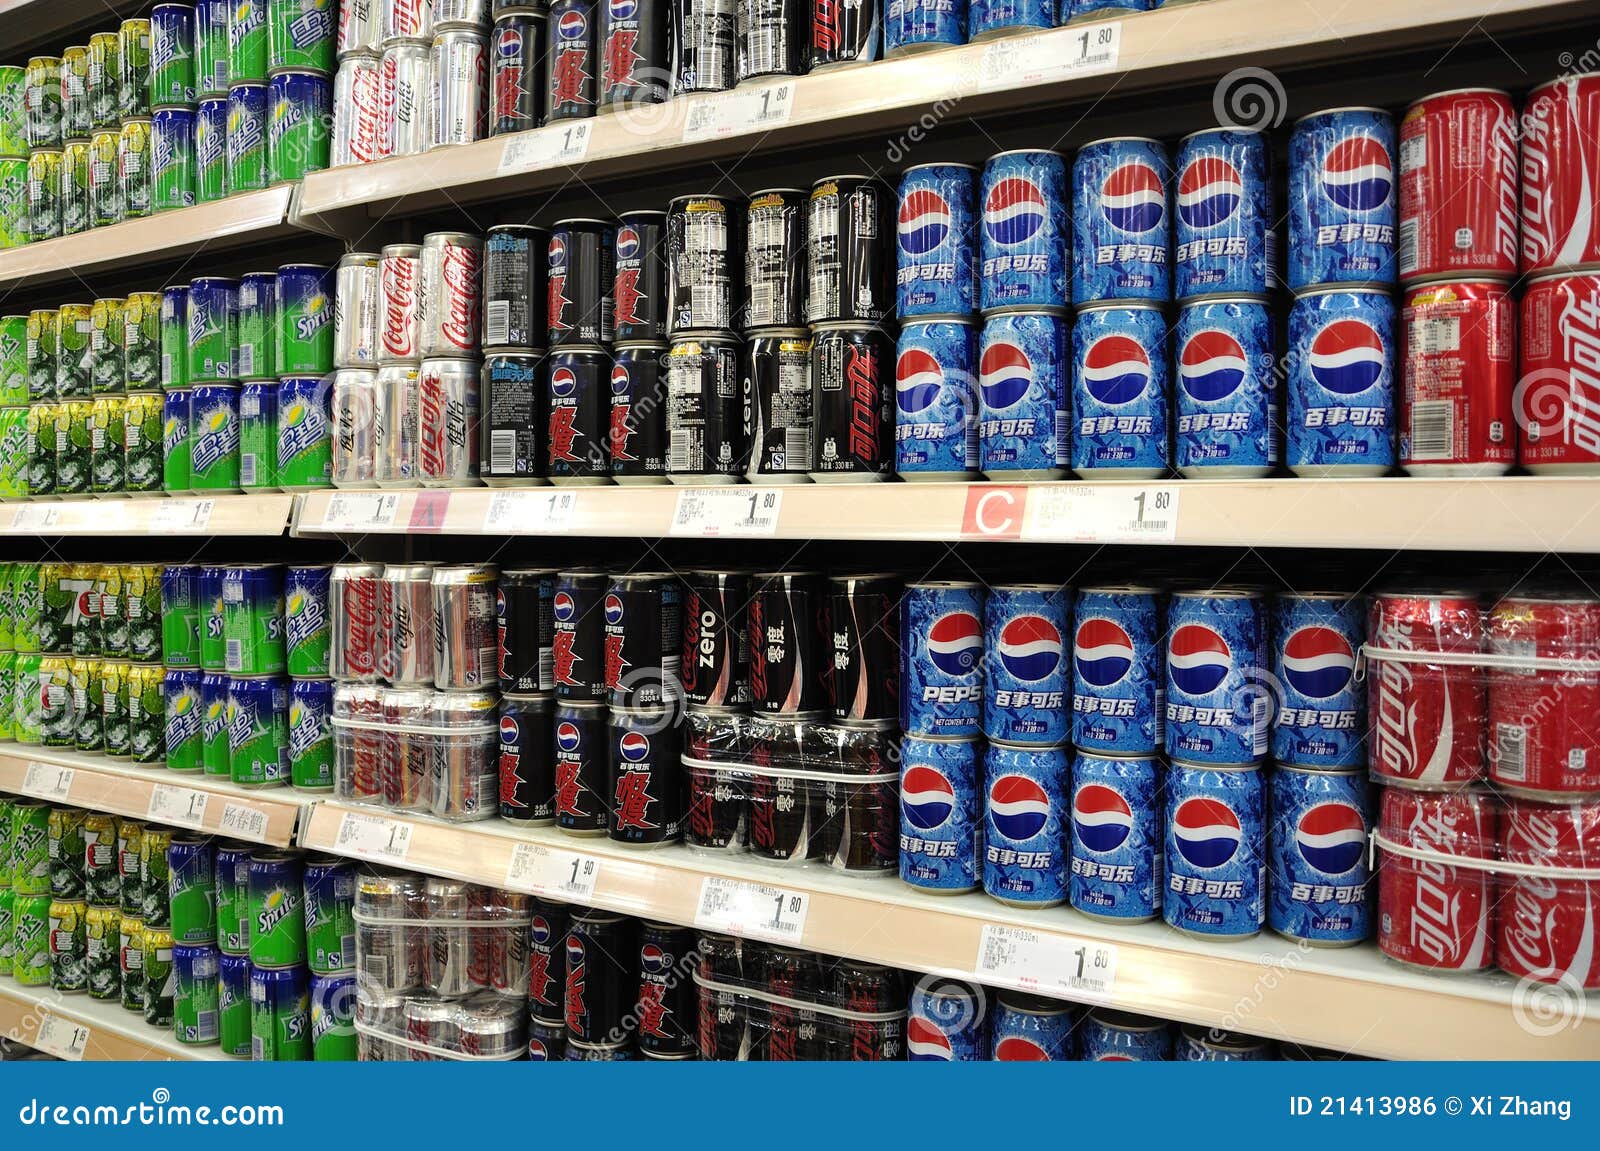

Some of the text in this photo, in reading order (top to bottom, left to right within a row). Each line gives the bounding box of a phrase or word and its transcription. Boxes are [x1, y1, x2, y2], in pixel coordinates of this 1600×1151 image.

[269, 107, 301, 144] Sprite
[1315, 224, 1394, 247] 百事可乐
[1096, 245, 1166, 266] 百事可乐
[1176, 236, 1248, 264] 百事可乐
[983, 254, 1049, 279] 百事可乐
[381, 253, 414, 358] Coca-Cola
[442, 239, 479, 350] Coca-Cola
[297, 305, 336, 341] Sprite
[743, 376, 752, 437] zero
[1303, 406, 1387, 429] 百事可乐
[1080, 415, 1153, 437] 百事可乐
[1178, 411, 1250, 435] 百事可乐
[277, 411, 326, 470] 雪碧
[416, 501, 435, 527] A
[975, 490, 1015, 534] C
[699, 610, 717, 669] zero
[766, 625, 785, 664] 零度
[834, 630, 850, 671] 零度
[922, 685, 983, 704] PEPS
[995, 690, 1065, 710] 百事可乐
[1073, 694, 1138, 718] 百事可乐
[1166, 702, 1234, 727] 百事可乐
[1278, 707, 1358, 730] 百事可乐
[899, 836, 959, 859] 百事可乐
[986, 845, 1052, 870] 百事可乐
[1071, 855, 1136, 884] 百事可乐
[1409, 798, 1459, 963] 可口可乐
[1169, 872, 1244, 900] 百事可乐
[1290, 882, 1367, 905] 百事可乐
[1504, 803, 1561, 976] Coca-Cola
[257, 893, 298, 936] Sprite
